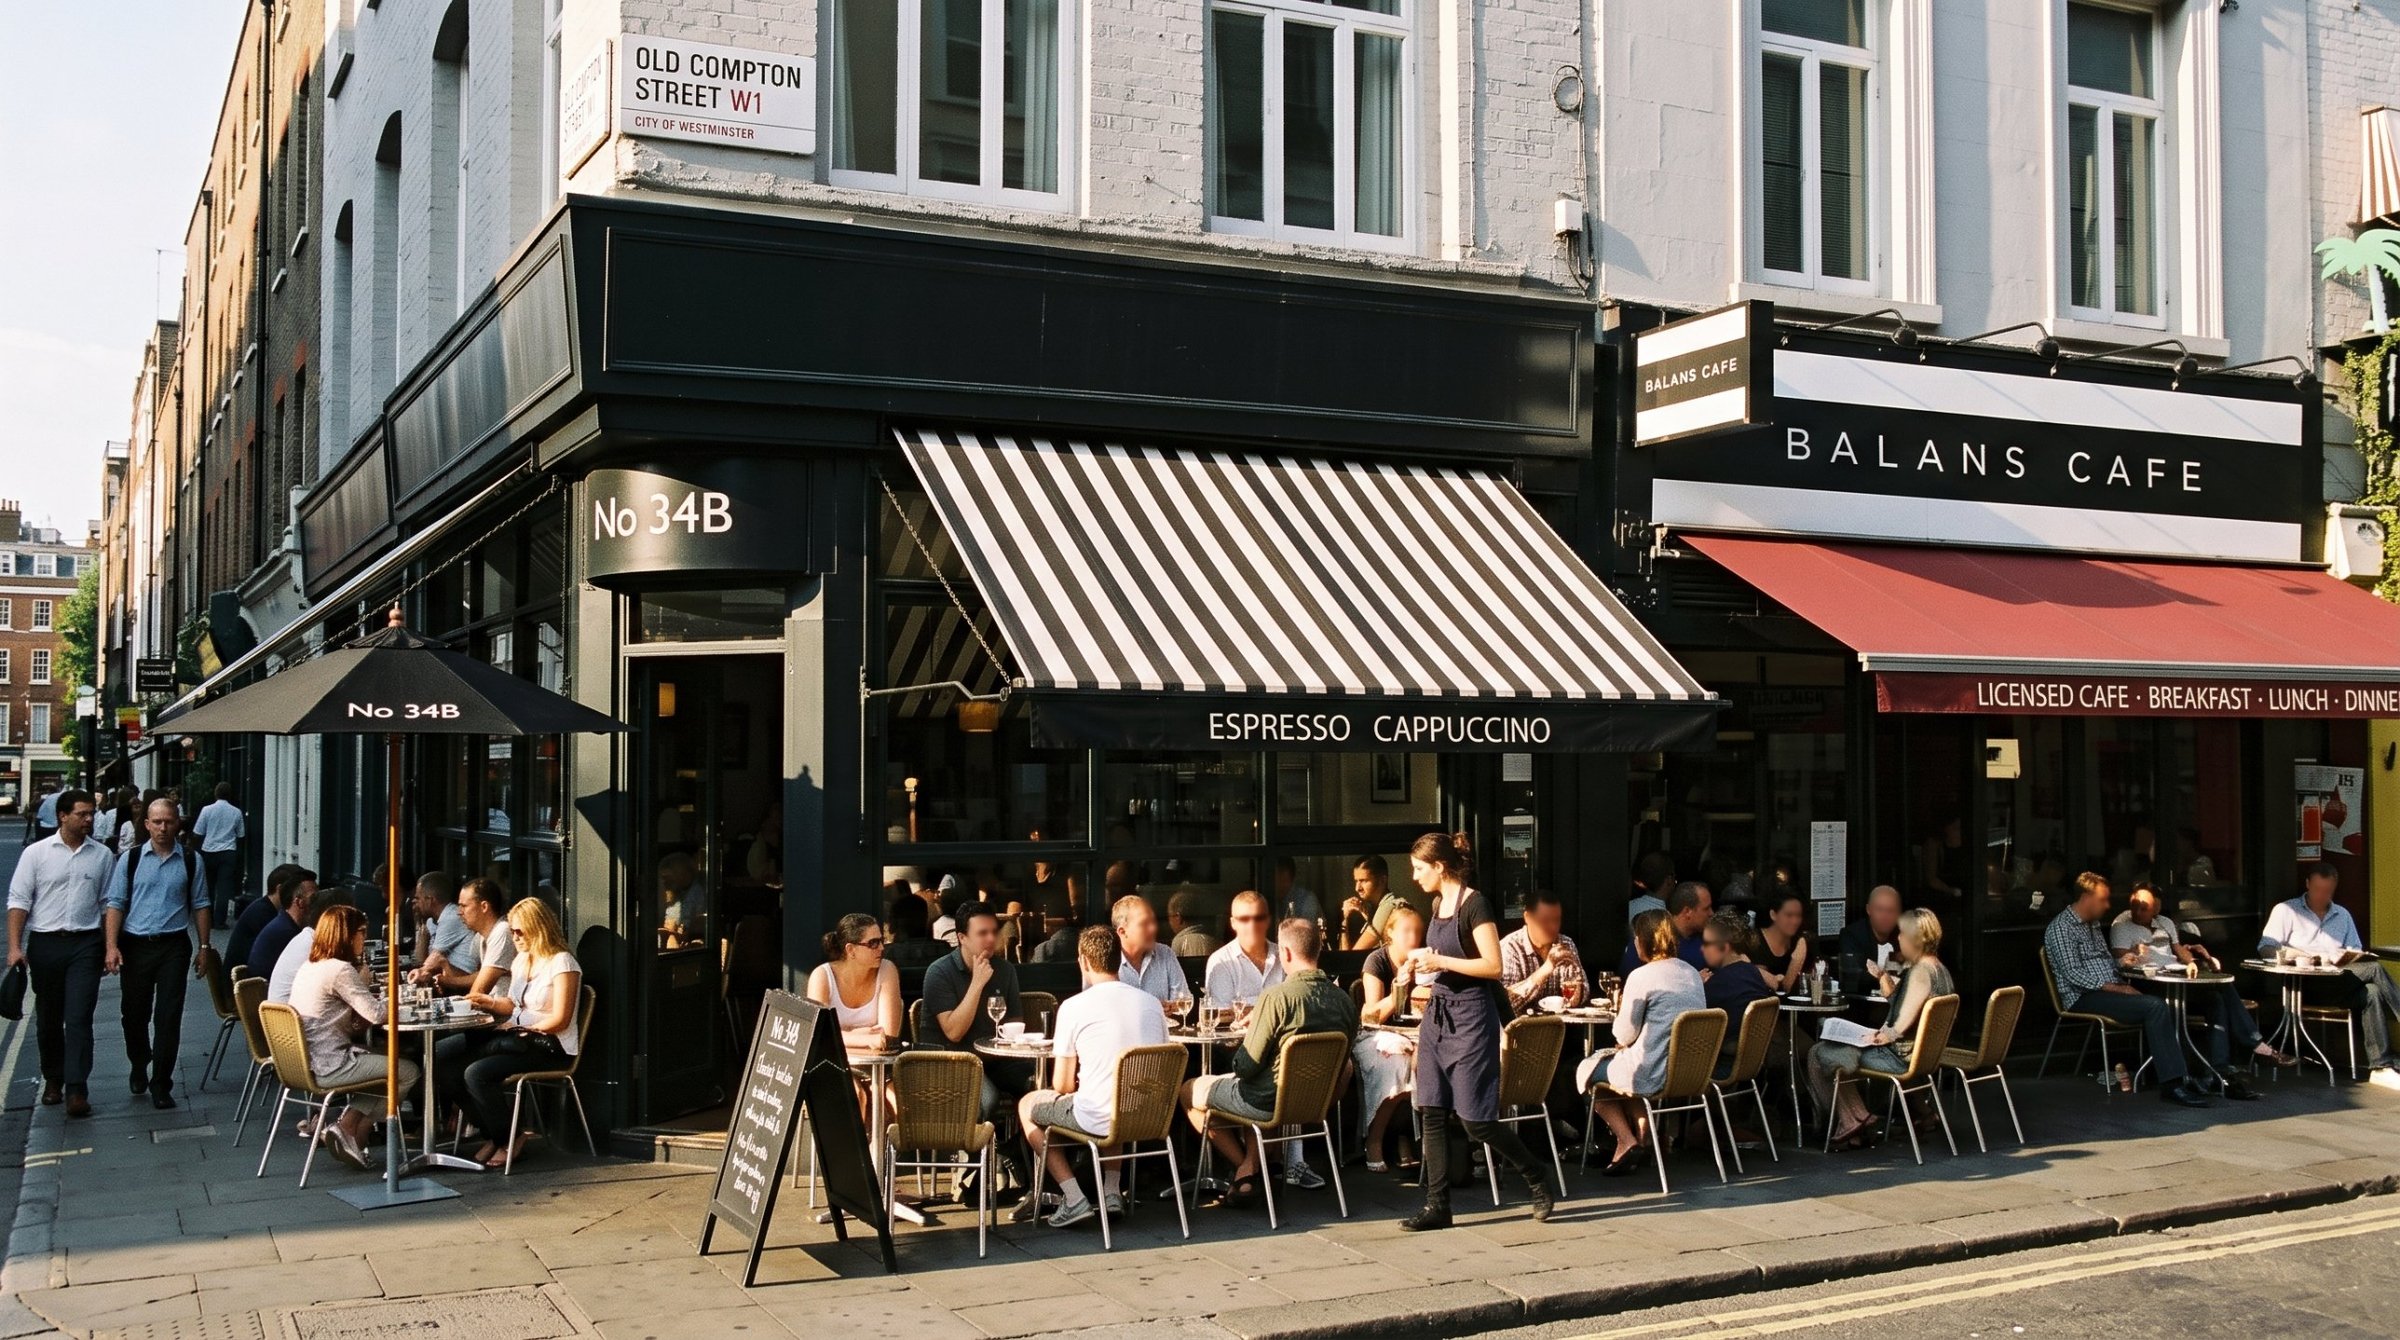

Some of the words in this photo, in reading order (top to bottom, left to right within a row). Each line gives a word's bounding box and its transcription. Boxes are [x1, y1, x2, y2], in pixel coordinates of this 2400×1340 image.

[636, 47, 680, 73] OLD
[690, 54, 801, 88] COMPTON
[635, 77, 722, 109] STREET
[730, 90, 761, 114] W1
[635, 116, 659, 129] CITY
[662, 119, 676, 131] OF
[679, 121, 755, 140] WESTMINSTER
[1645, 368, 1697, 393] BALANS
[1702, 357, 1737, 379] CAFE
[1787, 427, 2026, 479] BALANS
[2068, 451, 2203, 493] CAFE
[595, 497, 637, 540] No
[650, 492, 733, 535] 34B
[348, 702, 394, 718] No
[404, 703, 461, 719] 34B
[1978, 682, 2074, 707] LICENSED
[2079, 684, 2130, 708] CAFE
[2149, 686, 2252, 710] BREAKFAST
[2269, 688, 2329, 711] LUNCH
[2345, 689, 2400, 712] DINNE
[1209, 713, 1351, 741] ESPRESSO
[1373, 715, 1551, 743] CAPPUCCINO
[770, 1015, 784, 1040] No
